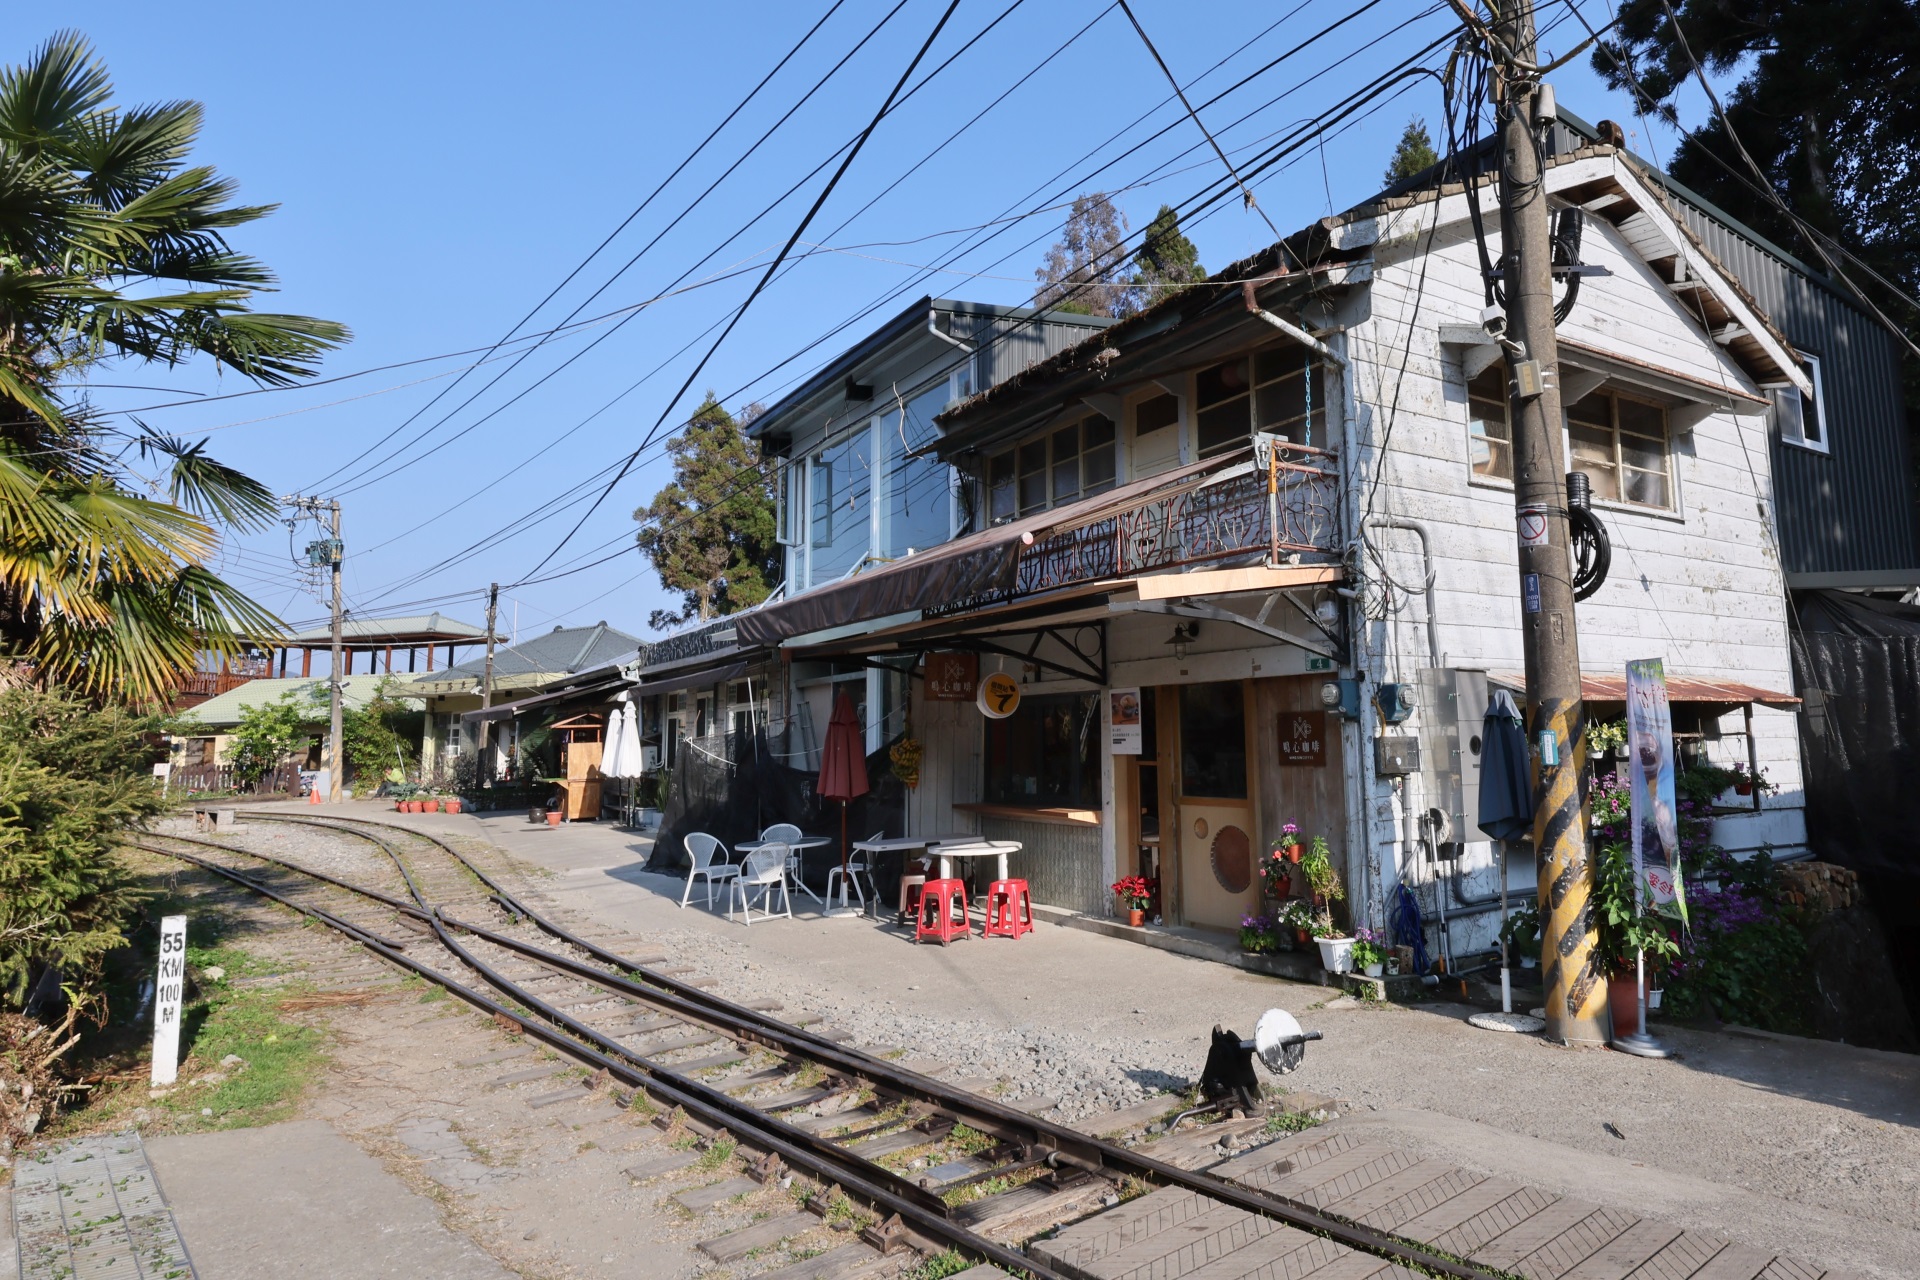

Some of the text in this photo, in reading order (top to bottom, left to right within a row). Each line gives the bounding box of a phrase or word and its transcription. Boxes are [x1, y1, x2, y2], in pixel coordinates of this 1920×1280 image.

[1316, 658, 1323, 668] 4
[163, 932, 183, 953] 55
[161, 957, 182, 978] KM
[159, 984, 180, 1003] 100
[162, 1007, 175, 1024] M
